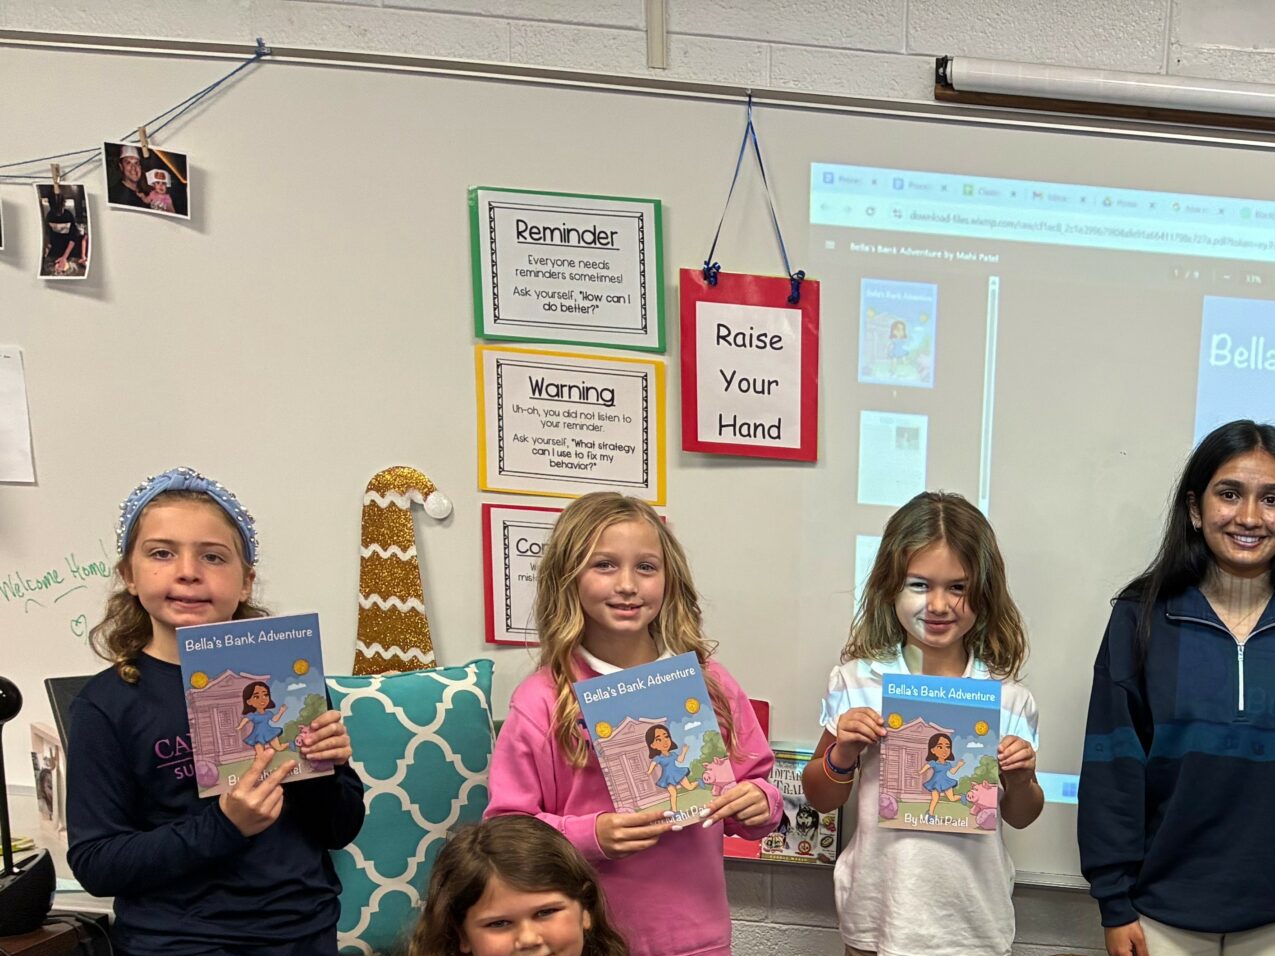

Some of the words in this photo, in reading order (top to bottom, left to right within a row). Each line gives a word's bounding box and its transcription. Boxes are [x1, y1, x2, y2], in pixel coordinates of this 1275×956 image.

[516, 219, 618, 246] Reminder
[528, 255, 575, 269] Everyone
[579, 260, 610, 270] needs
[850, 243, 875, 252] Bella's
[877, 244, 896, 254] Bank
[900, 247, 941, 258] Adventure
[945, 251, 953, 261] by
[956, 251, 977, 261] Mahi
[978, 253, 999, 263] Patel
[515, 268, 566, 280] reminders
[569, 272, 622, 283] sometimes!
[513, 286, 531, 297] Ask
[534, 288, 576, 301] yourself,
[579, 291, 603, 302] "How
[543, 302, 557, 312] do
[561, 303, 599, 314] better?"
[716, 324, 783, 350] Raise
[529, 376, 615, 407] Warning
[720, 369, 779, 395] Your
[512, 404, 540, 417] Uh-oh,
[543, 409, 560, 417] you
[563, 408, 578, 419] did
[580, 410, 595, 420] not
[598, 411, 620, 422] listen
[622, 414, 632, 423] to
[541, 420, 560, 429] your
[563, 422, 604, 432] reminder.
[718, 413, 781, 440] Hand
[513, 433, 528, 443] Ask
[532, 435, 569, 448] yourself,
[571, 438, 596, 448] "What
[598, 441, 635, 453] strategy
[532, 447, 550, 456] can
[557, 449, 571, 458] use
[575, 450, 584, 459] to
[587, 451, 597, 460] fix
[600, 453, 613, 463] my
[550, 459, 596, 470] behavior?"
[0, 568, 64, 601] Welcome
[186, 637, 222, 651] Bella's
[225, 632, 255, 647] Bank
[258, 629, 312, 642] Adventure
[583, 687, 617, 704] Bella's
[618, 678, 646, 694] Bank
[648, 667, 695, 687] Adventure
[888, 684, 918, 697] Bella's
[921, 686, 946, 699] Bank
[948, 688, 996, 702] Adventure
[945, 816, 968, 827] Patel
